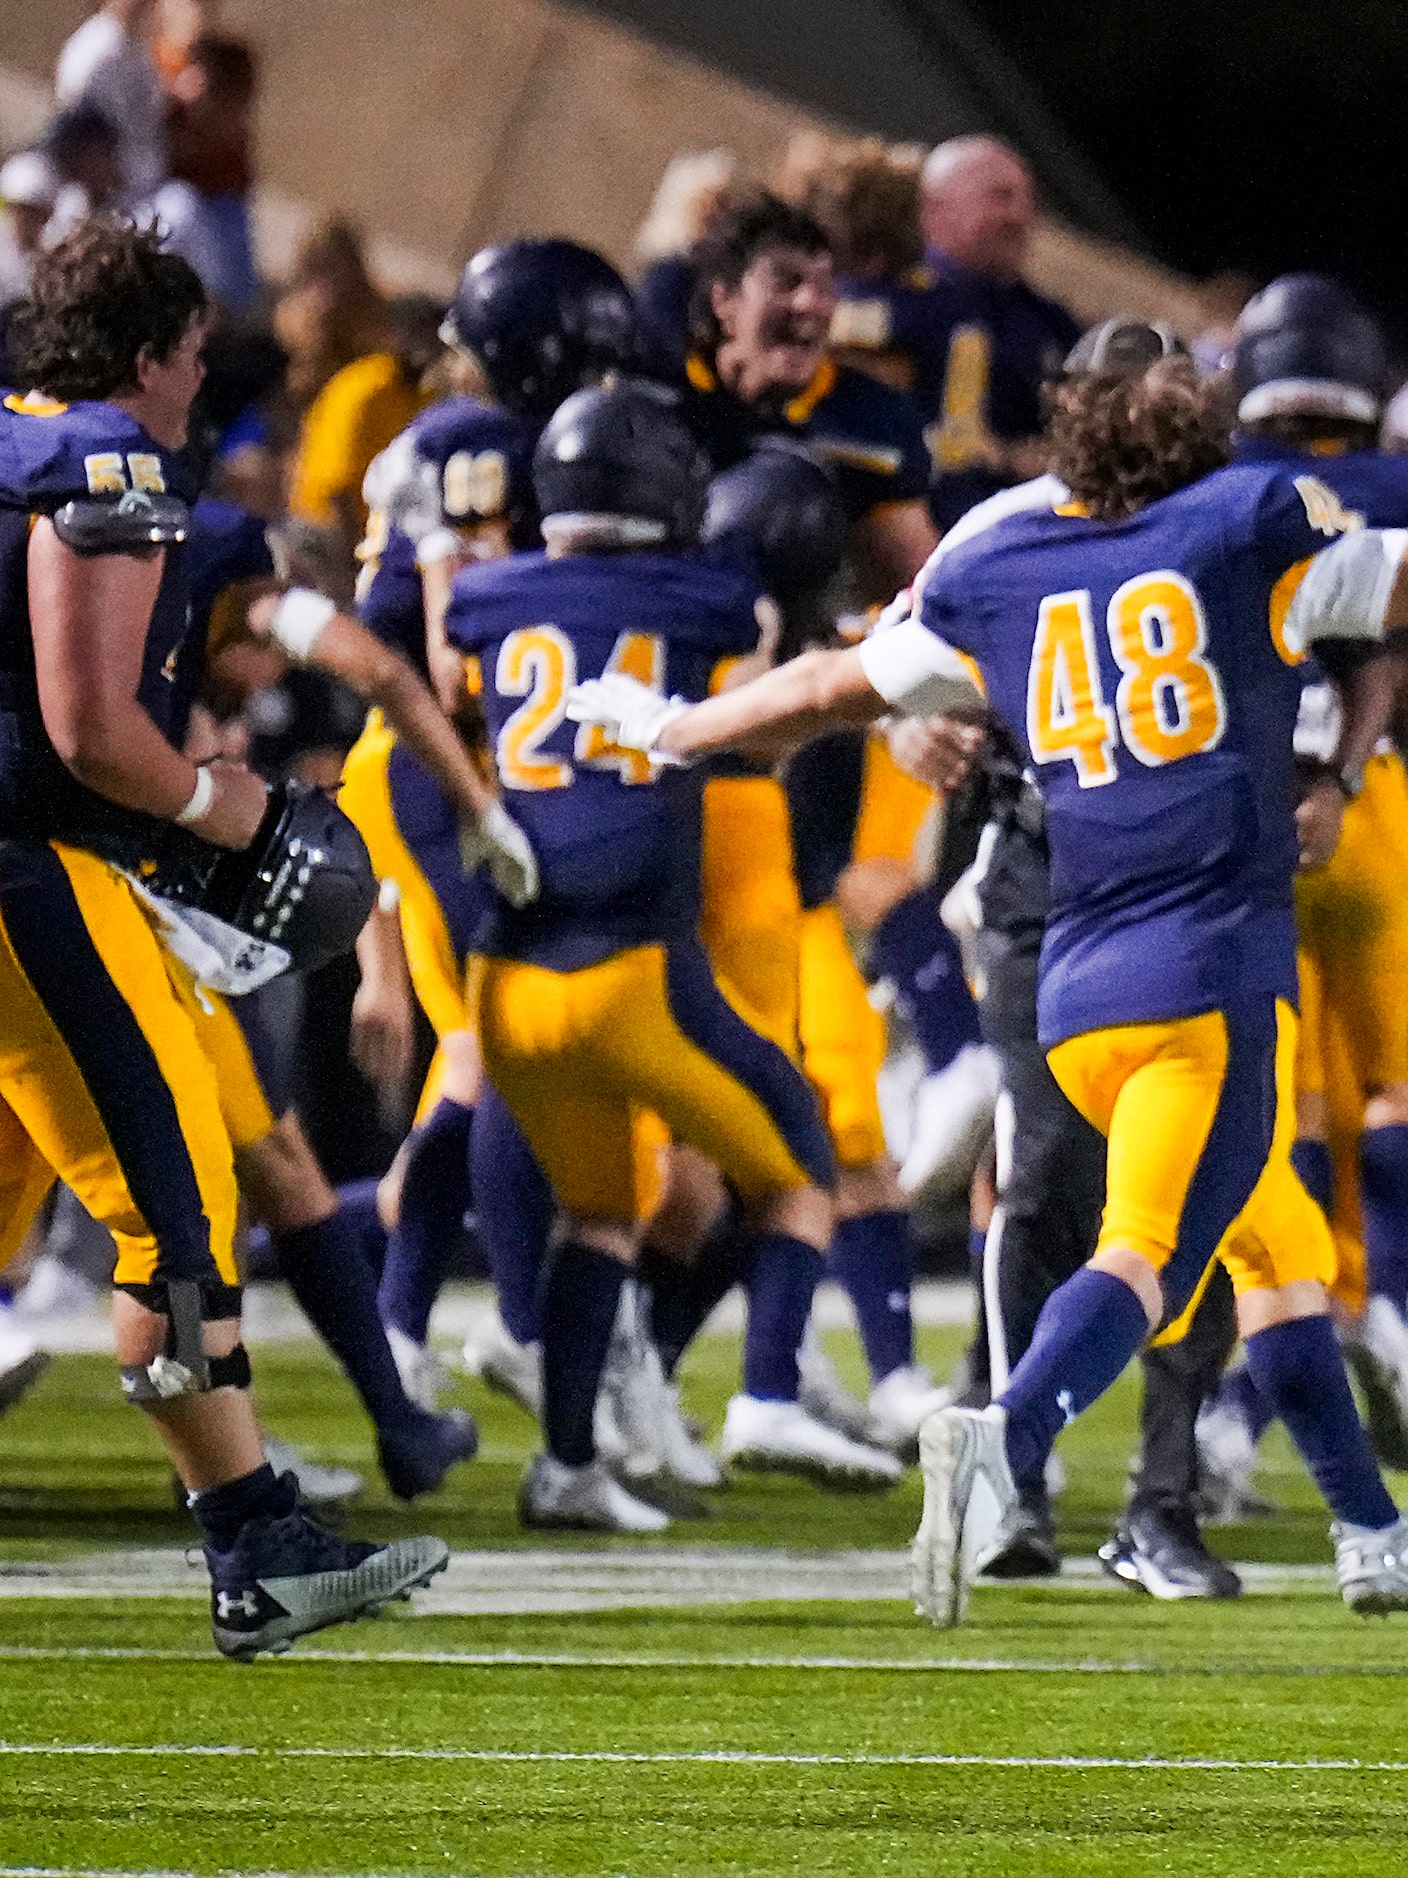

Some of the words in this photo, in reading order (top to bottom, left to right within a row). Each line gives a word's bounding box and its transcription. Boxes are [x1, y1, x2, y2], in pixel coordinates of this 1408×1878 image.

[84, 452, 165, 494] 55
[495, 623, 667, 791] 24
[1026, 568, 1228, 789] 48
